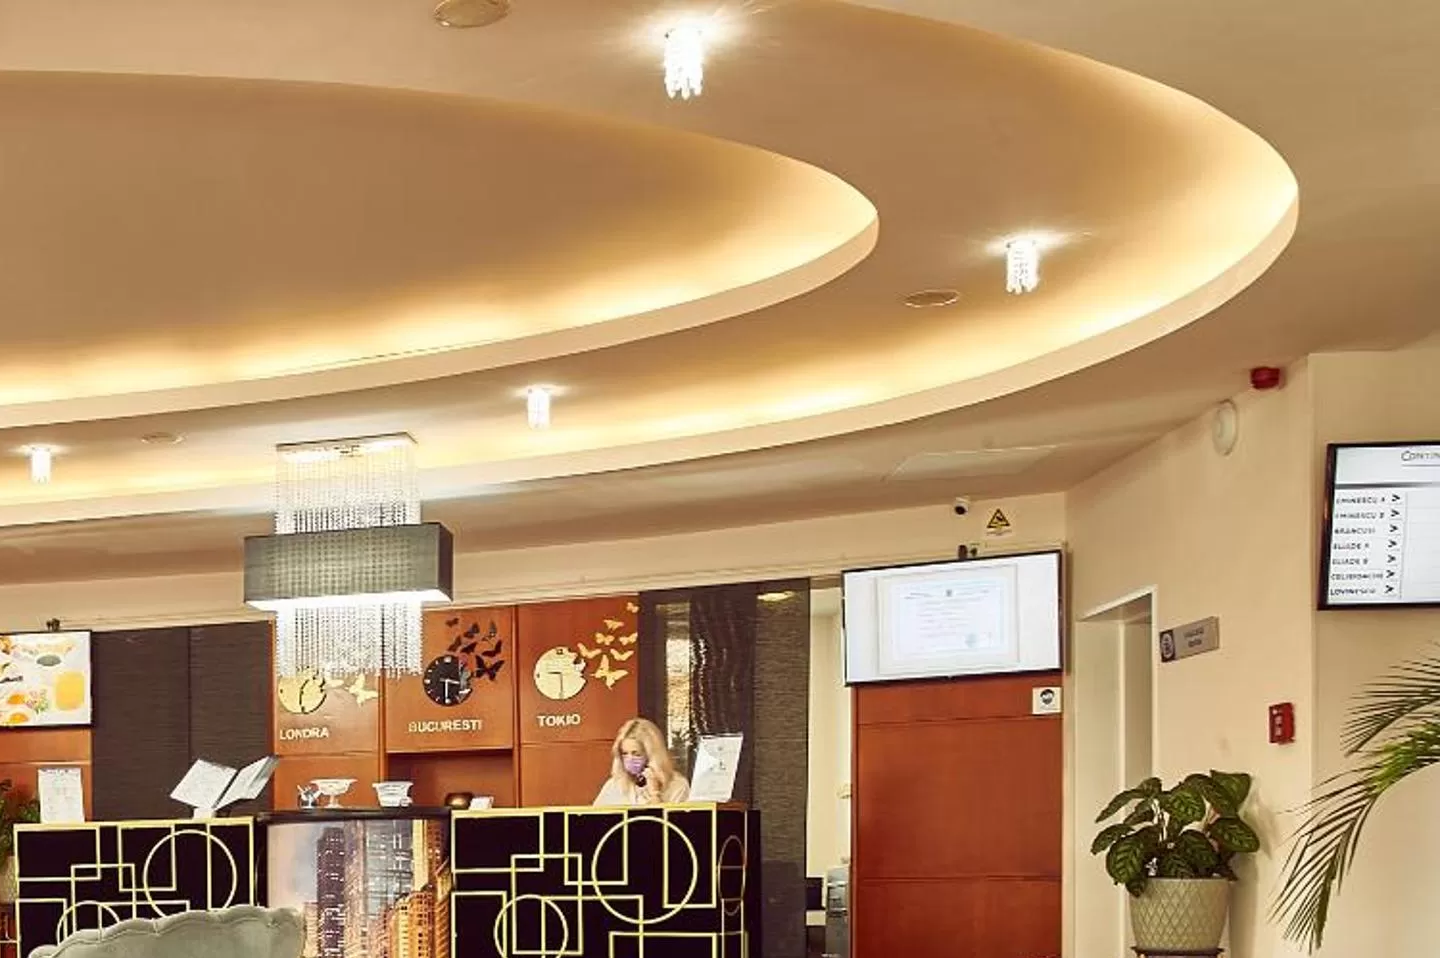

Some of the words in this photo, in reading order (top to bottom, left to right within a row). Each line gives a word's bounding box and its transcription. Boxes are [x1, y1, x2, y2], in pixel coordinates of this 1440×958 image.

[408, 719, 483, 733] BUCURESTI
[536, 713, 581, 727] TOKIO
[279, 727, 329, 740] LONDRA
